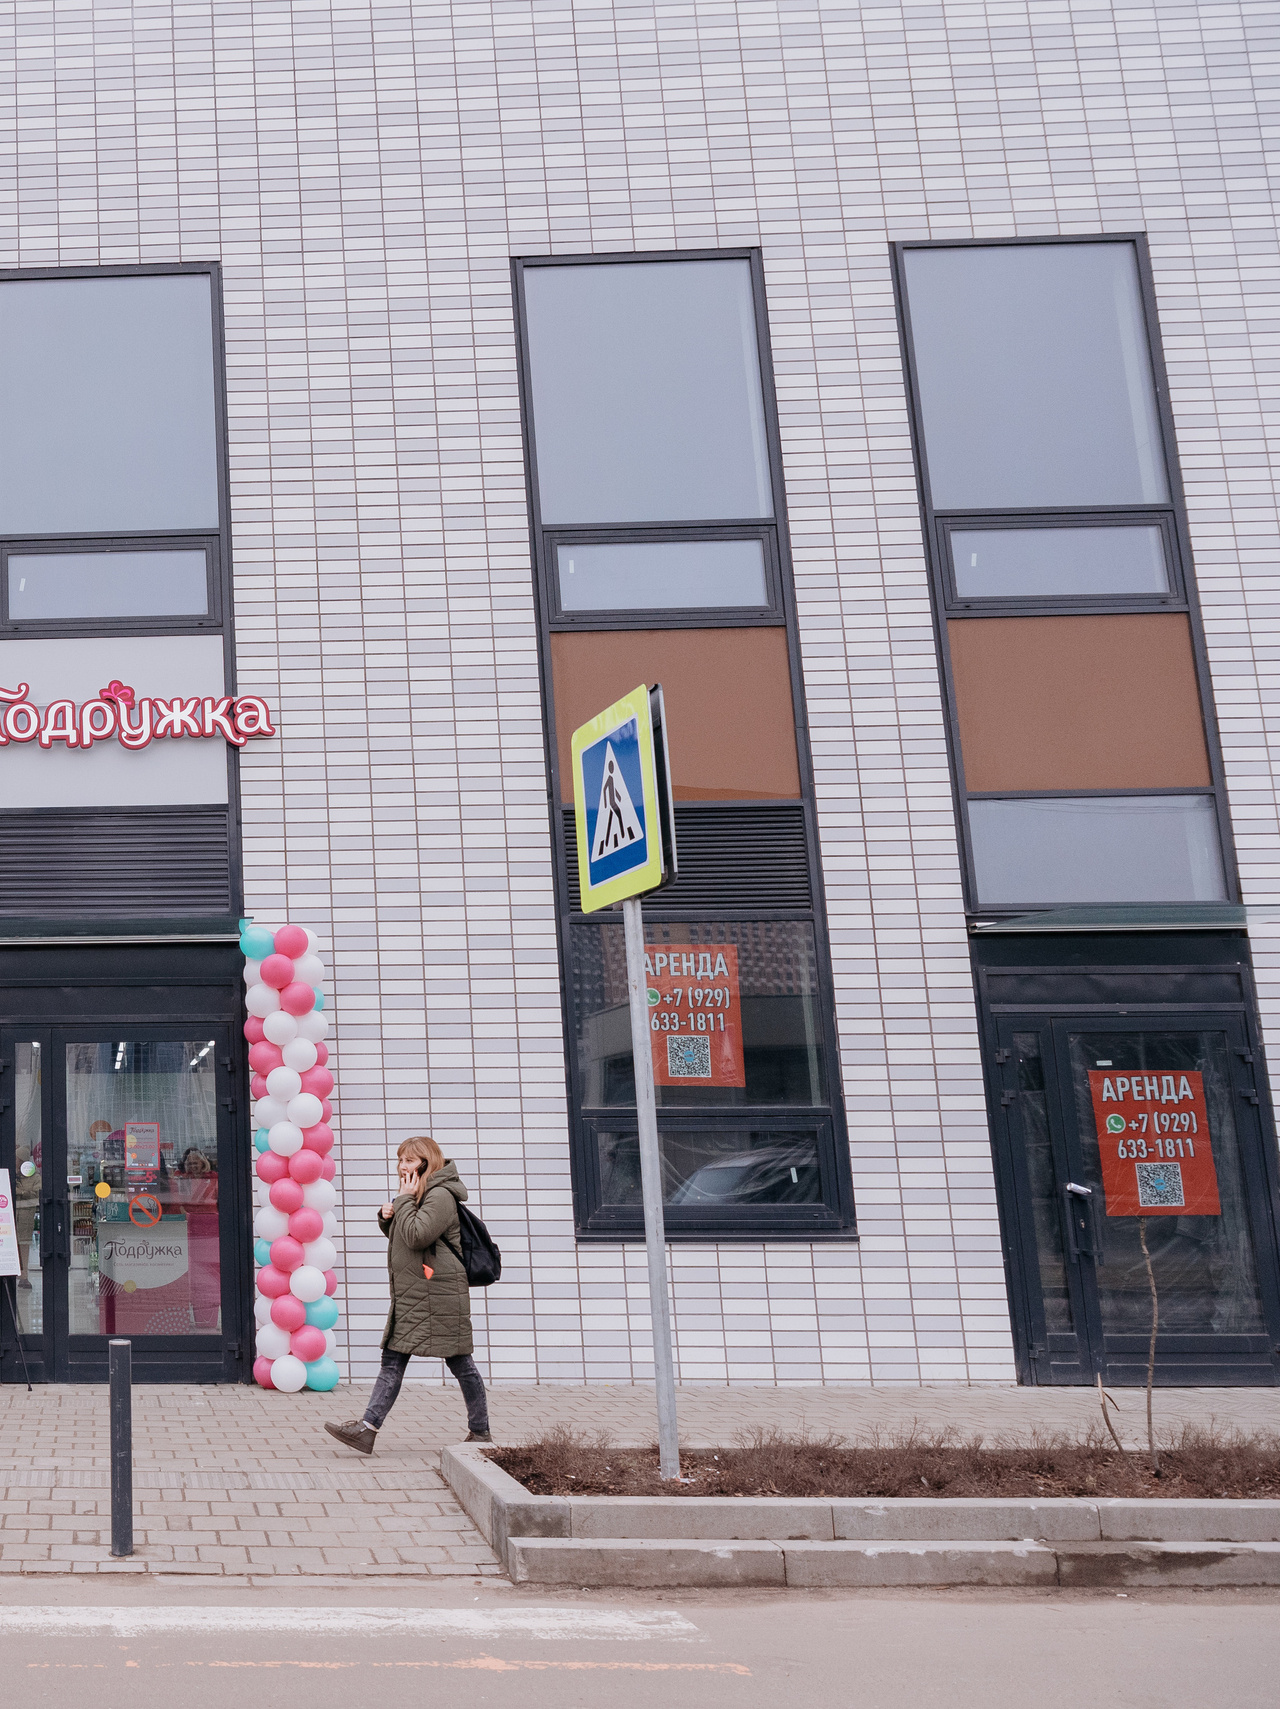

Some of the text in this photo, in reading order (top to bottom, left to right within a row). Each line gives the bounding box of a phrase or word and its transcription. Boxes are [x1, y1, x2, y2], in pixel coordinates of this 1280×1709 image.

[644, 952, 729, 980] АРЕНДА
[663, 986, 730, 1009] +7 (929)
[650, 1012, 726, 1032] 633-1811
[1101, 1075, 1195, 1104] АРЕНДА
[1128, 1111, 1198, 1134] +7 (929)
[1117, 1138, 1195, 1159] 633-1811
[103, 1238, 183, 1261] Подружка
